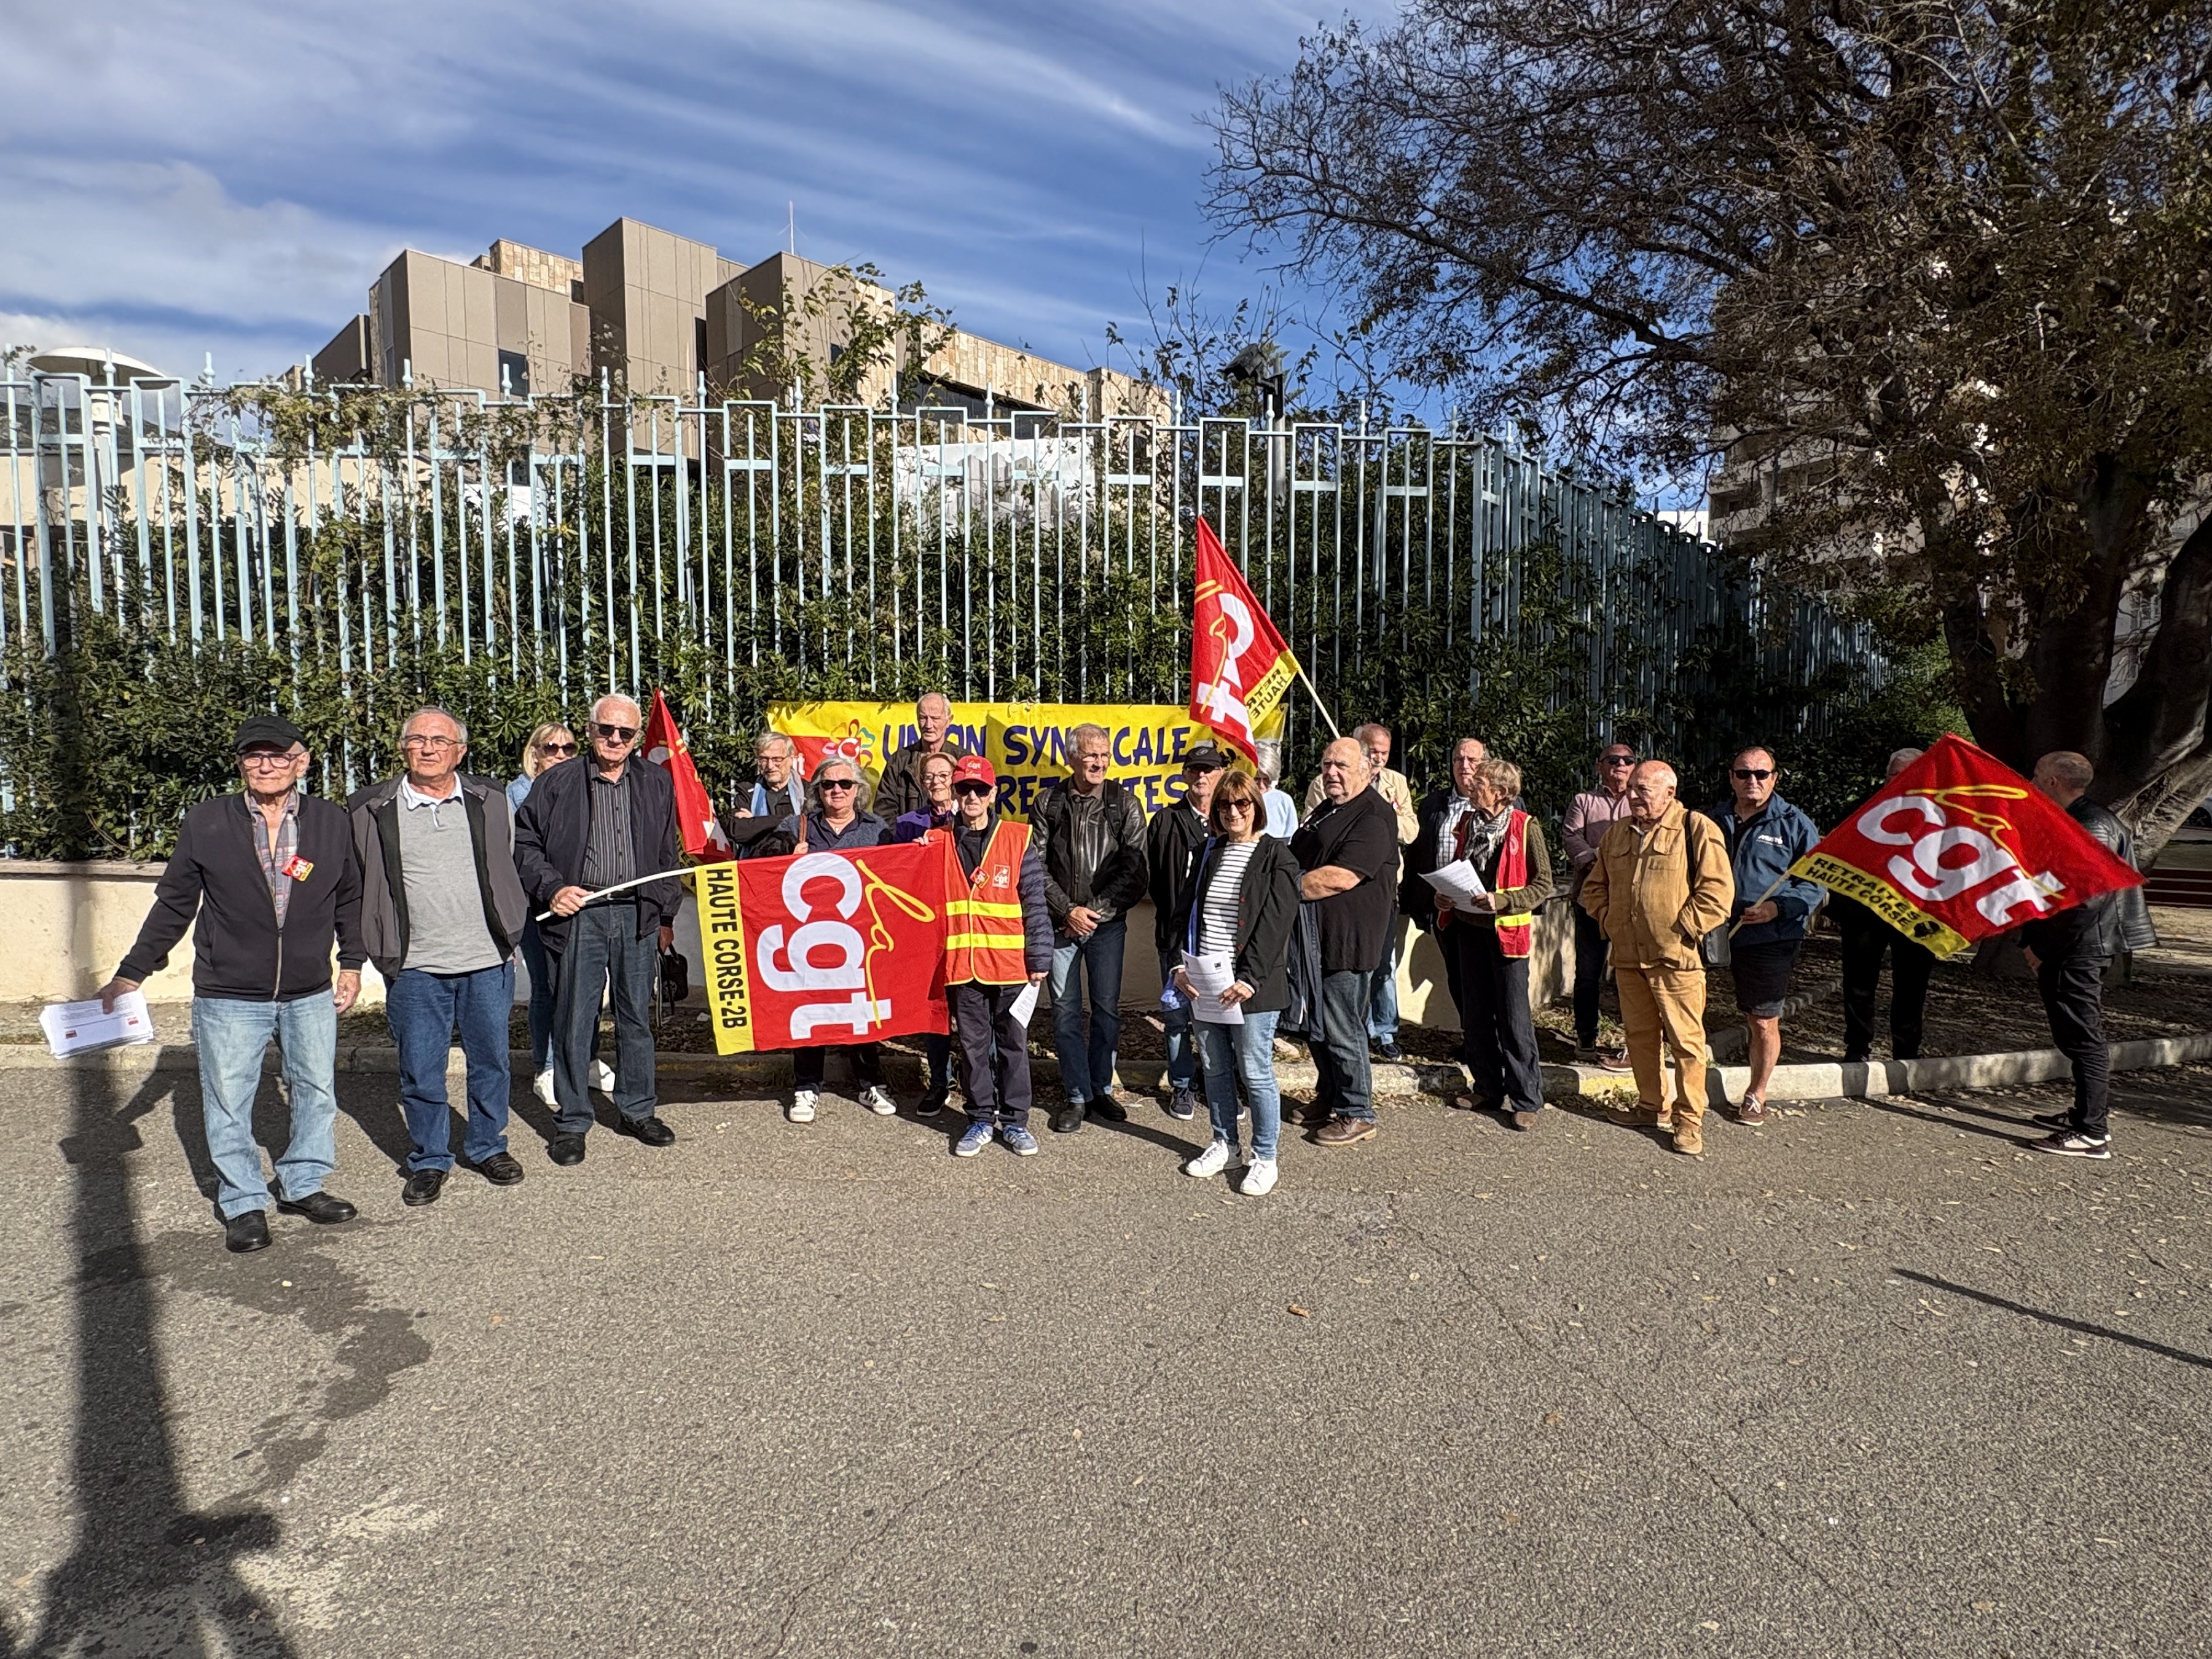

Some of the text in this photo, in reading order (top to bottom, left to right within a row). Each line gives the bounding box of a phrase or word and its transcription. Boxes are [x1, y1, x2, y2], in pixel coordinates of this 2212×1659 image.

[1003, 725, 1191, 767] SYNCALE
[994, 874, 1008, 885] cgt
[1814, 857, 1921, 920] RETRAITES
[1857, 796, 2066, 927] cgt
[706, 868, 737, 934] HAUTE
[1805, 866, 1912, 927] HAUTE CORSE
[756, 852, 892, 1040] cgt
[713, 938, 748, 1029] CORSE-2B
